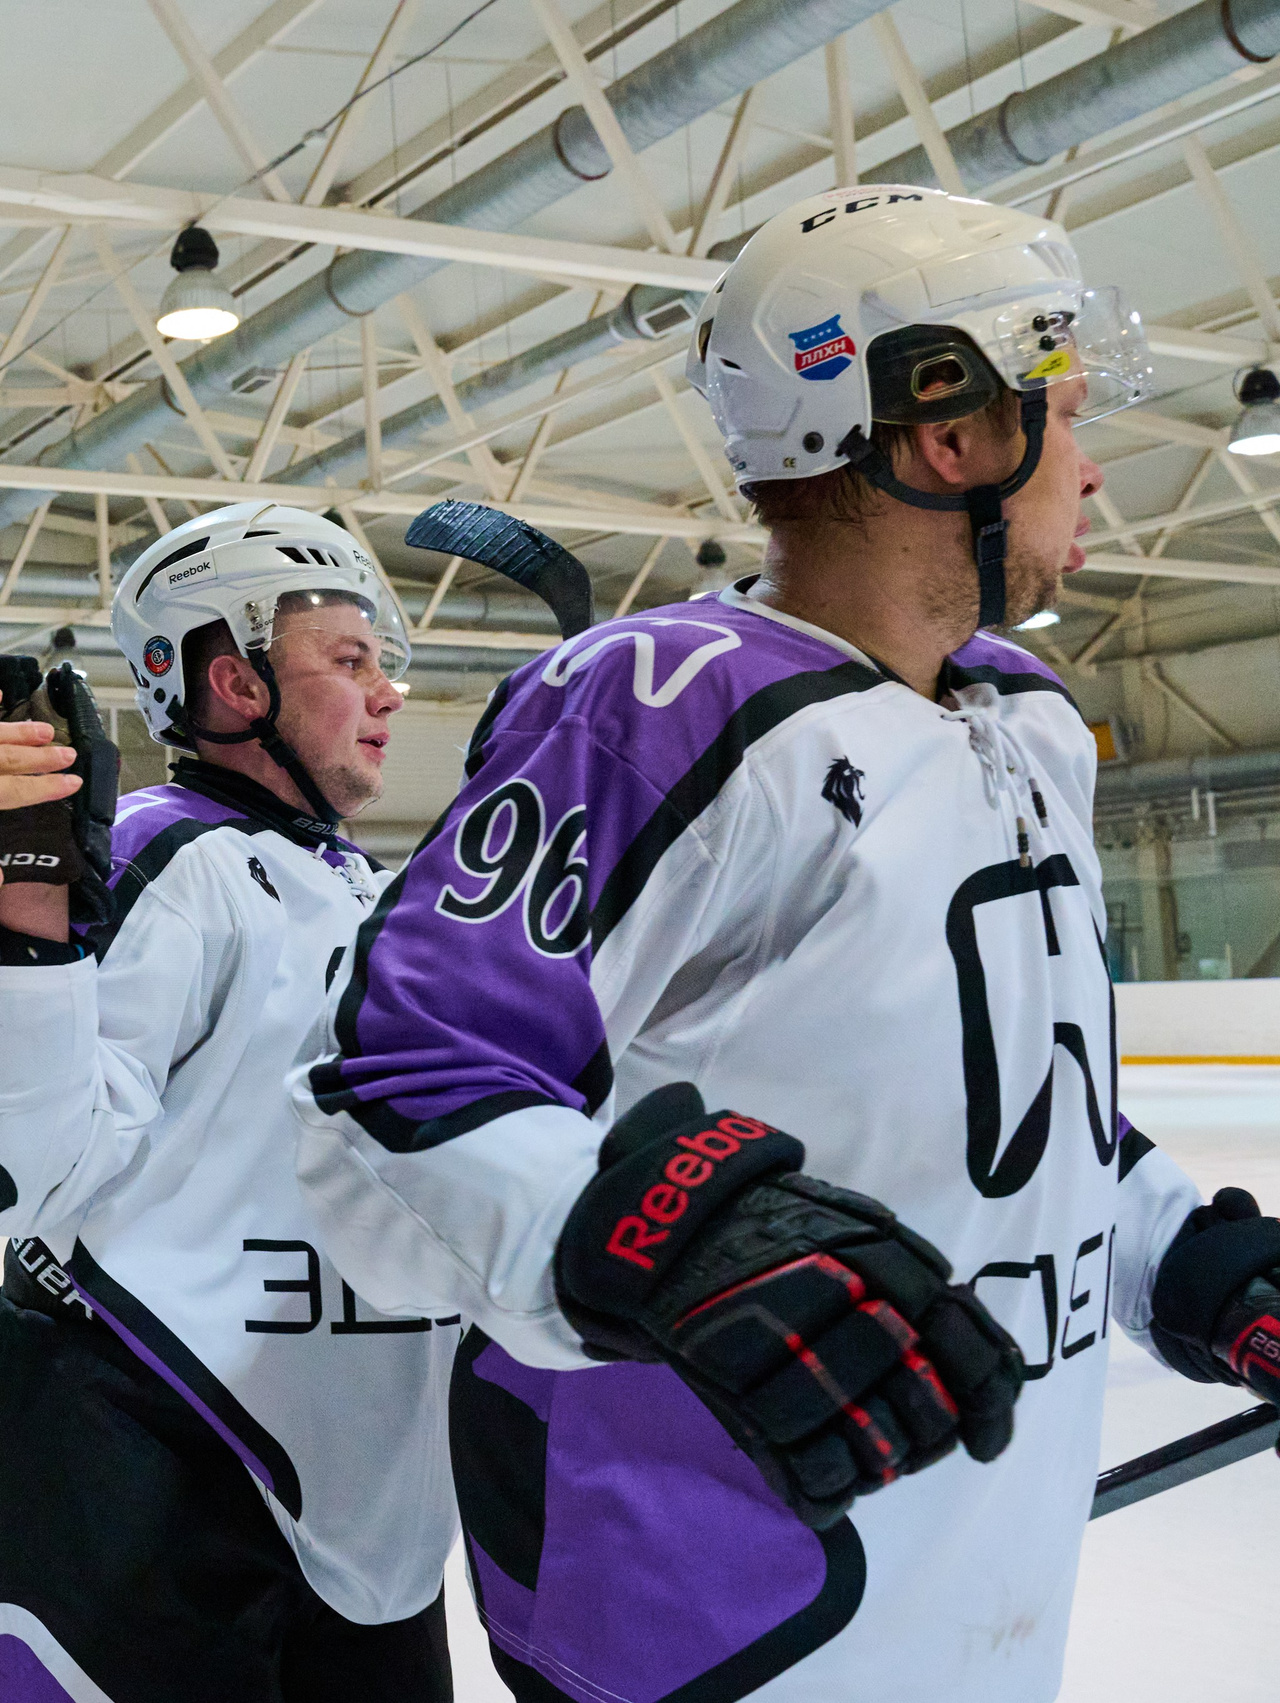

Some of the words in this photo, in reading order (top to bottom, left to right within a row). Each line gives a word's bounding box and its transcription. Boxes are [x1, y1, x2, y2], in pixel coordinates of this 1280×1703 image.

[800, 193, 924, 234] CCM
[168, 561, 212, 585] Reebok
[434, 777, 593, 960] 96
